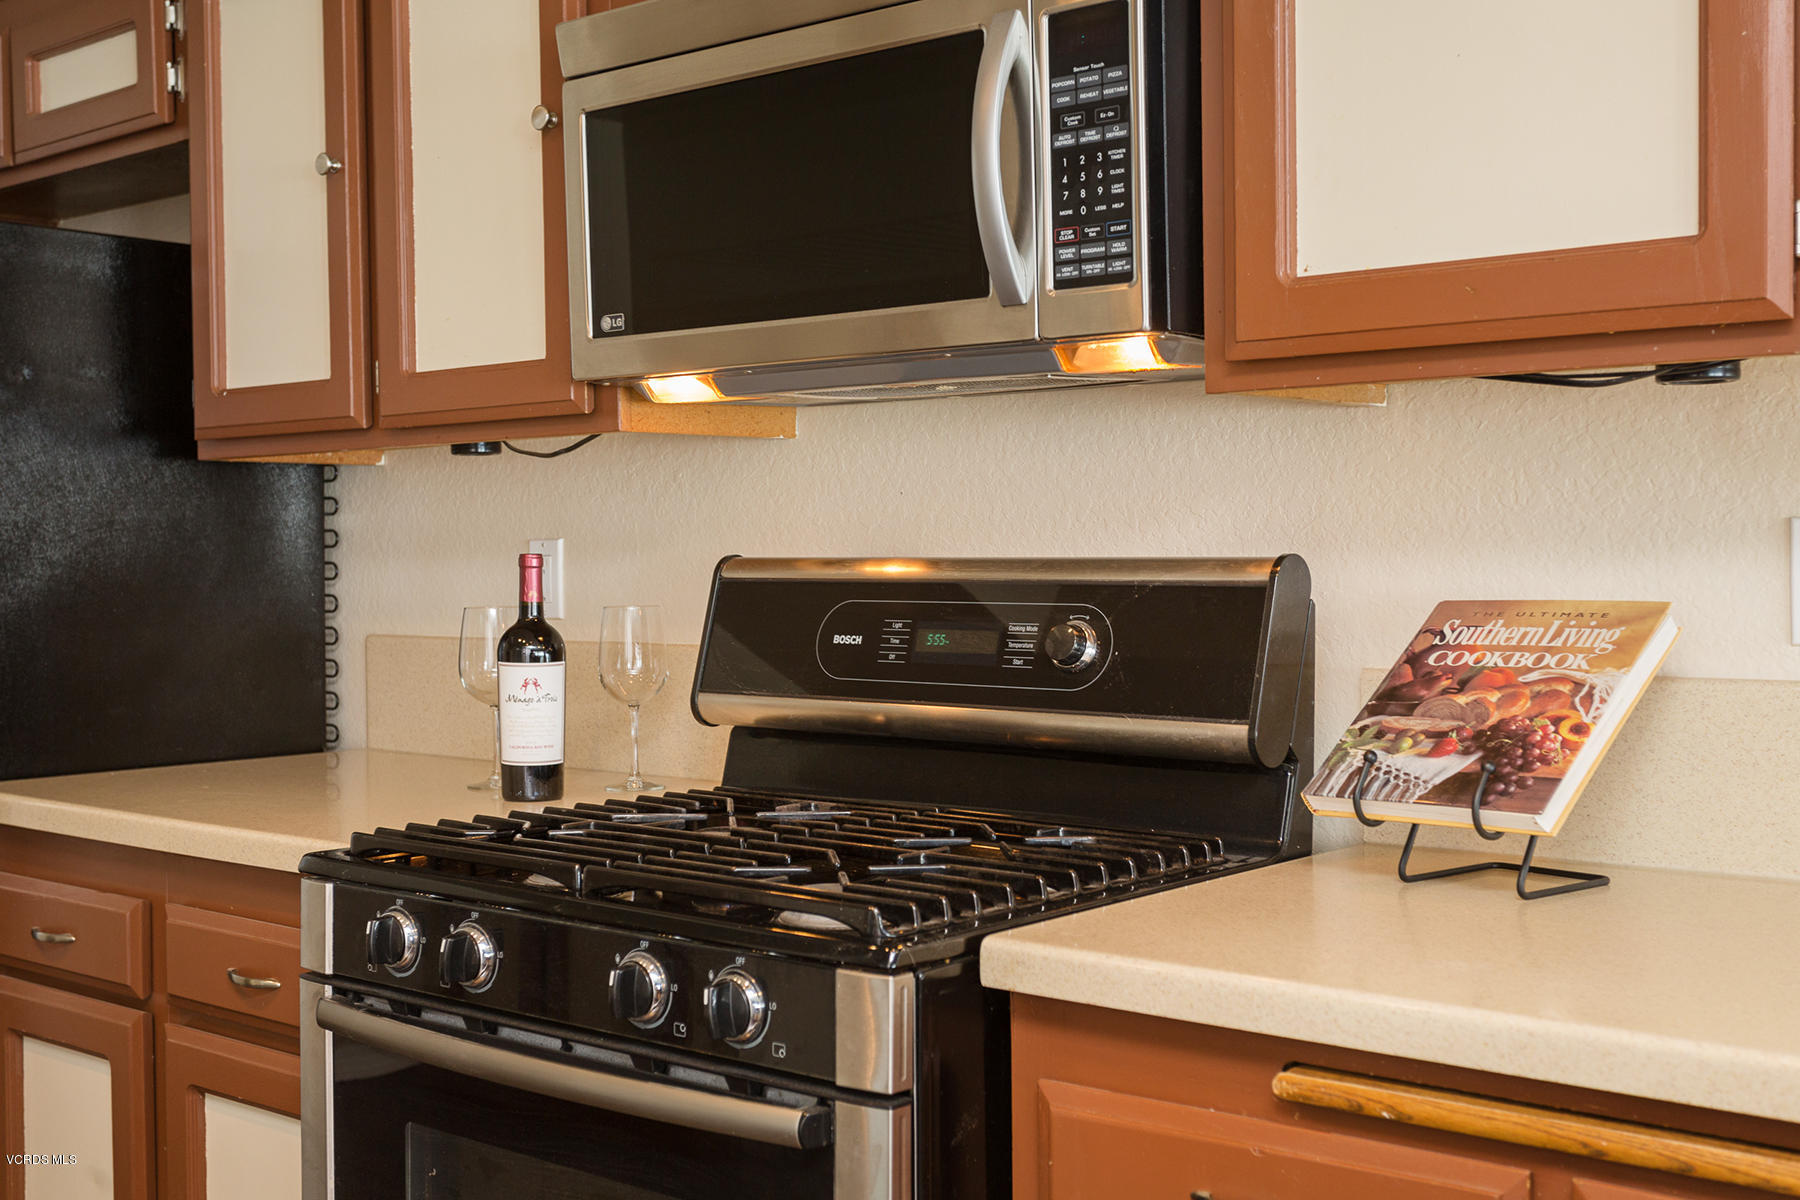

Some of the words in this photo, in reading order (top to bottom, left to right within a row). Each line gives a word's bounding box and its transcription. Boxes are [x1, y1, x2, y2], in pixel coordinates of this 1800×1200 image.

[1052, 80, 1075, 88] POPCORN
[1103, 85, 1128, 95] VEGETABLE
[1063, 158, 1066, 167] 1
[1080, 155, 1085, 165] 2
[1097, 152, 1102, 162] 3
[1062, 174, 1068, 184] 4
[1080, 172, 1086, 181] 5
[1097, 169, 1103, 179] 6
[1063, 191, 1069, 200] 7
[1080, 189, 1086, 198] 8
[1097, 186, 1103, 196] 9
[1080, 205, 1086, 215] 0
[833, 634, 862, 644] BOSCH
[1432, 619, 1544, 646] Southern
[1538, 620, 1626, 654] Living
[1427, 650, 1598, 670] COOKBOOK
[736, 957, 745, 965] OFF
[671, 984, 678, 992] LO
[769, 1002, 776, 1011] LO
